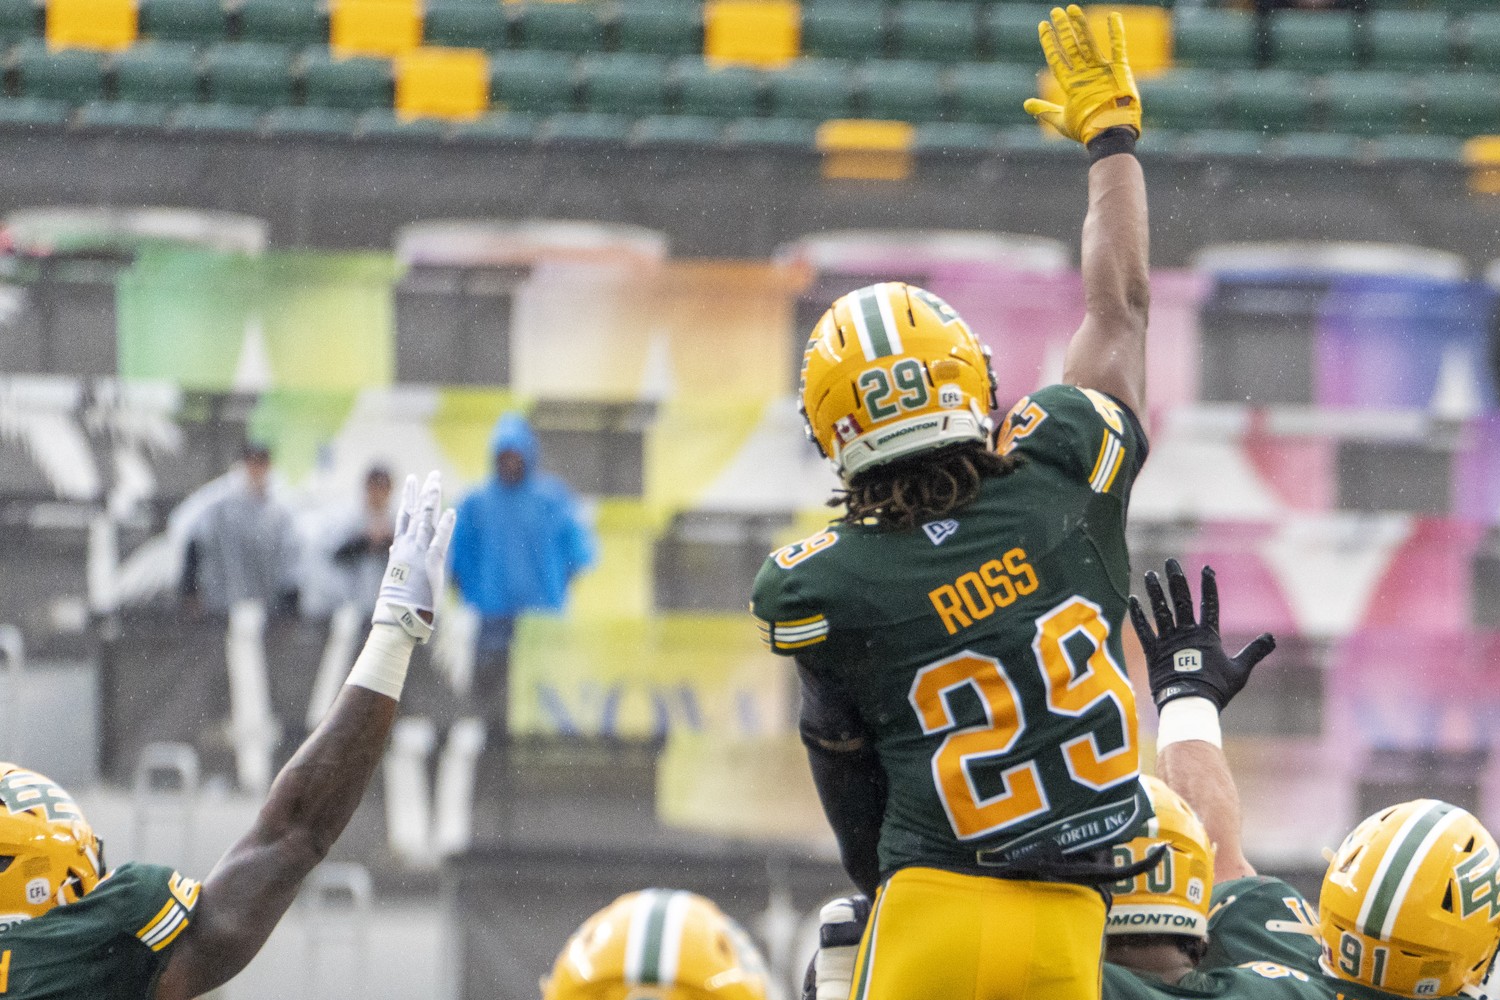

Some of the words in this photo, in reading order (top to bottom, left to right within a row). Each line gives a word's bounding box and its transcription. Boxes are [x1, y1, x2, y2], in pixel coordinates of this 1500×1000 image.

[859, 358, 930, 423] 29
[942, 392, 959, 404] CFL
[877, 421, 938, 445] EDMONTON
[391, 567, 405, 581] CFL
[927, 548, 1041, 635] ROSS
[1177, 654, 1198, 667] CFL
[907, 594, 1141, 842] 29
[29, 886, 47, 900] CFL
[1188, 884, 1201, 900] CFL
[1338, 931, 1390, 987] 91
[1416, 984, 1435, 994] CFL
